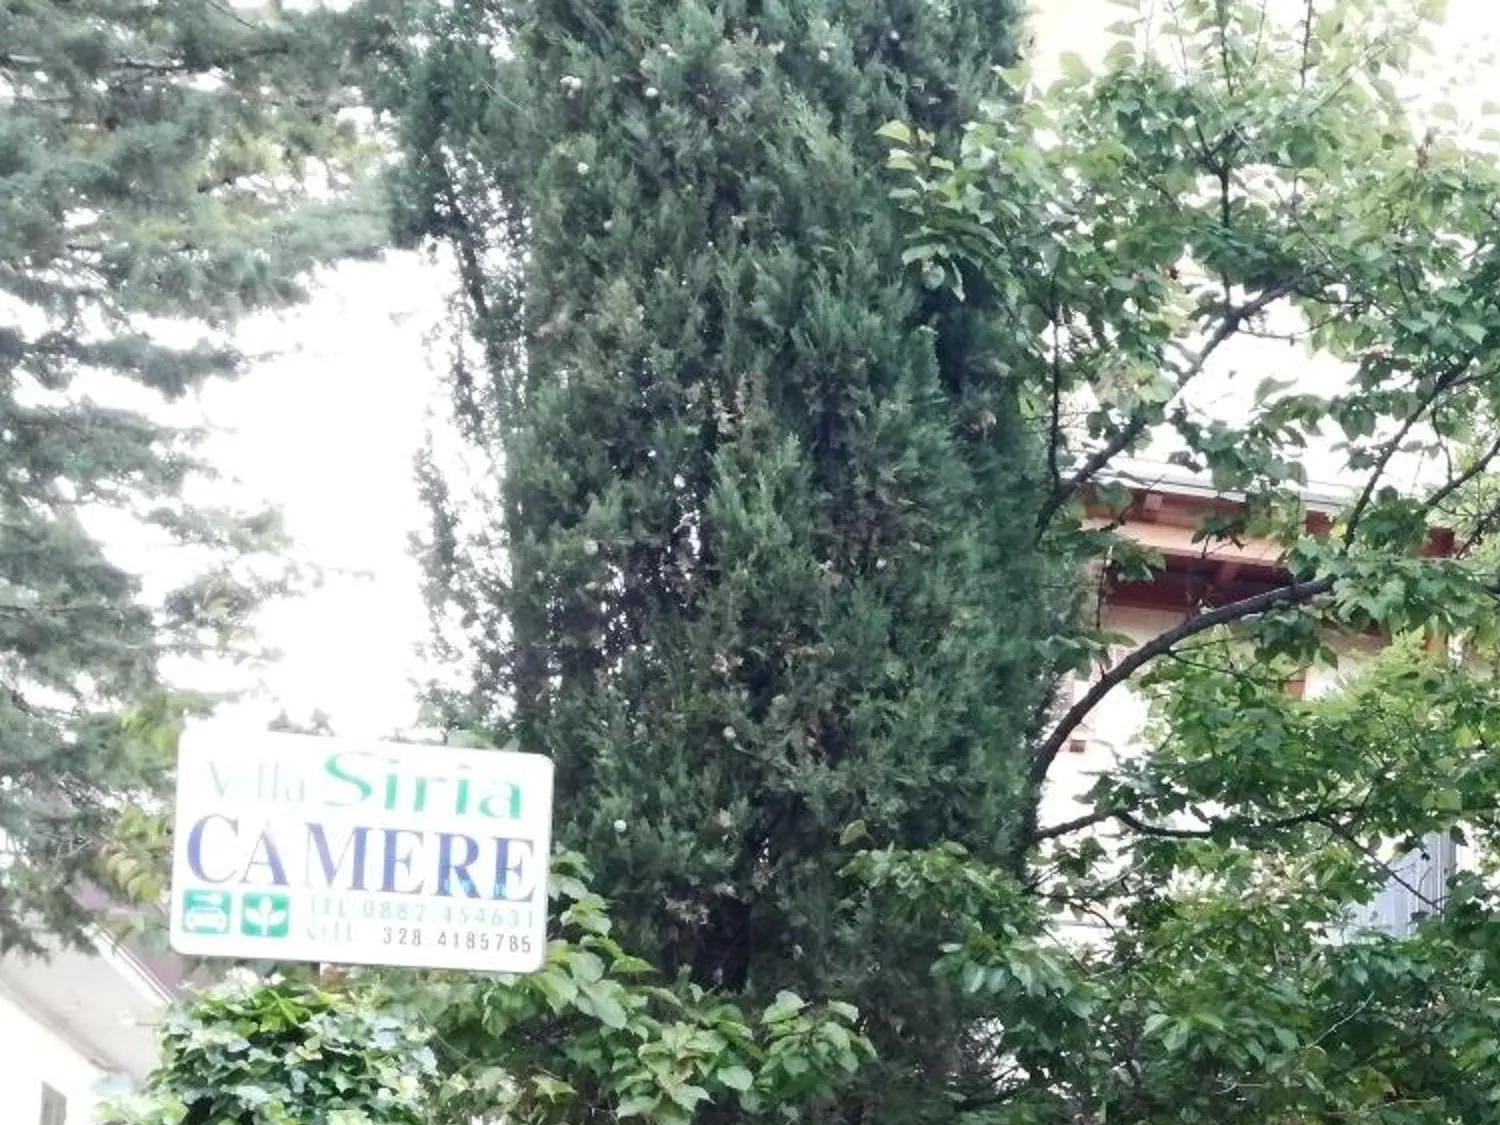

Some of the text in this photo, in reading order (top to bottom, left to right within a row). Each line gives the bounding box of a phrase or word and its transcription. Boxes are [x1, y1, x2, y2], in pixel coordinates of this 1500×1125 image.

[208, 750, 523, 820] Vlla Siria
[186, 812, 536, 903] CAMERE
